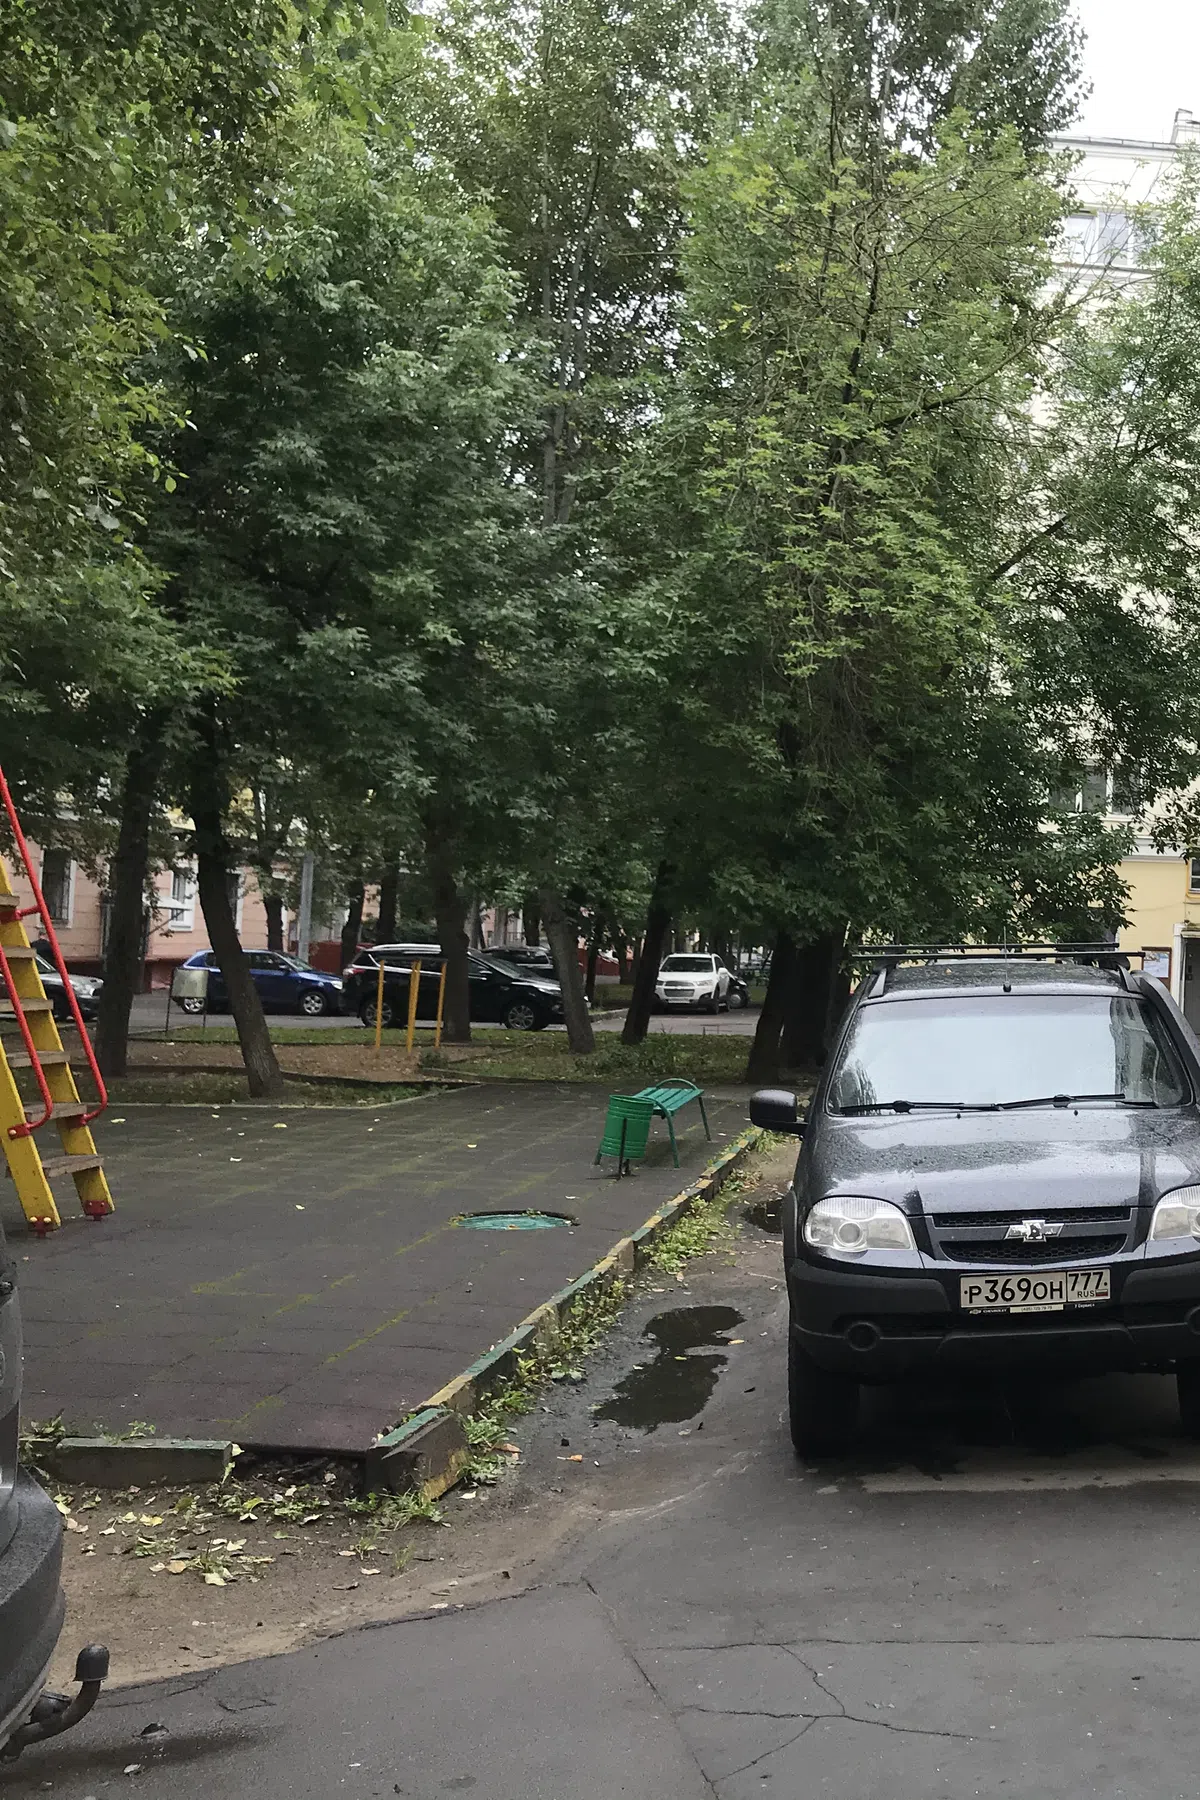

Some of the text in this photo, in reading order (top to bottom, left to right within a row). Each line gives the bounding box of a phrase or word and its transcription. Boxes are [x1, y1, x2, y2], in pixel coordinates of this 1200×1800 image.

[969, 1271, 1103, 1304] Р369ОН 777
[1077, 1290, 1095, 1298] RUS
